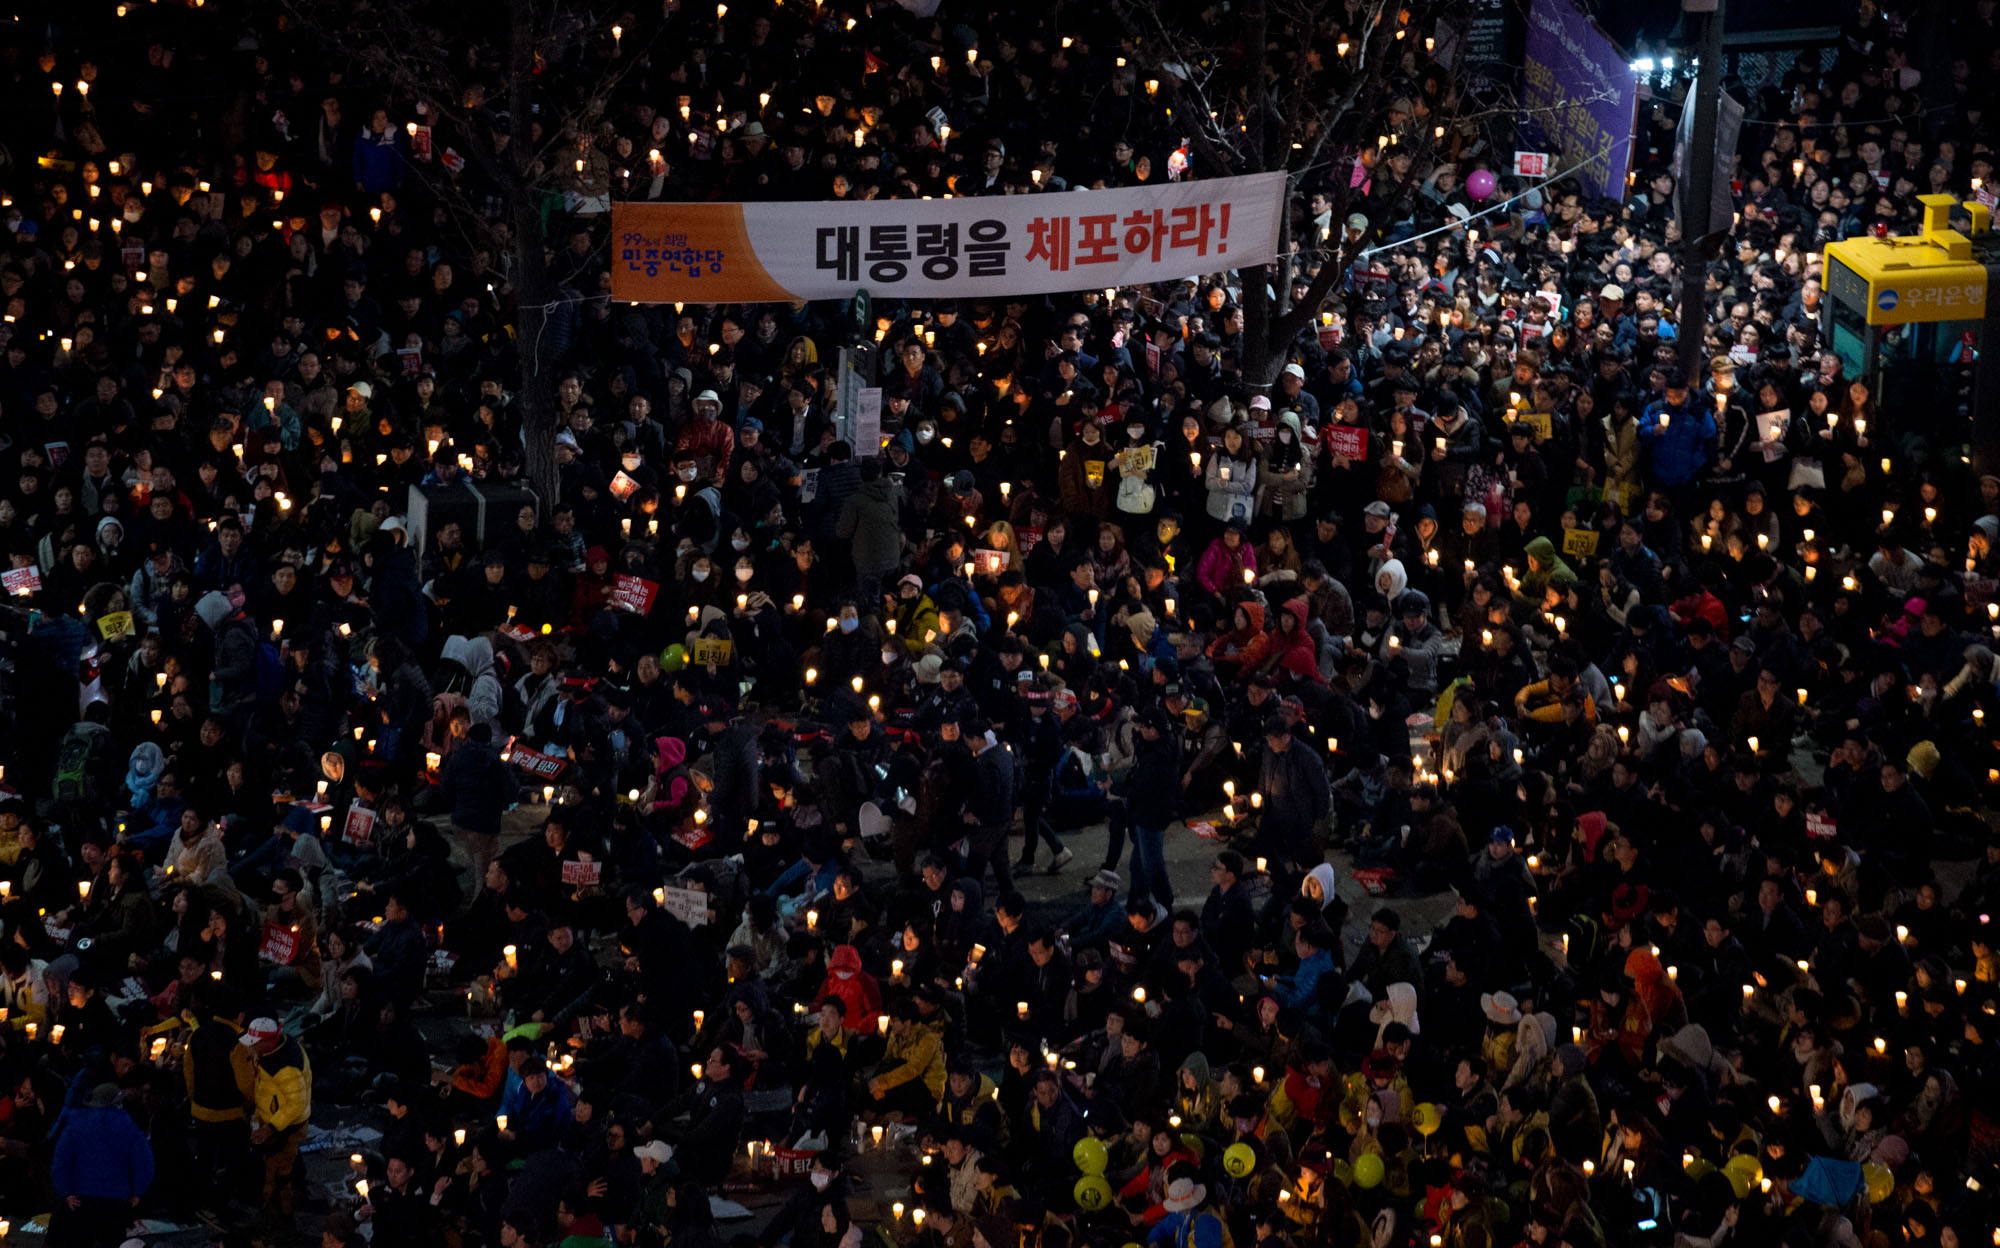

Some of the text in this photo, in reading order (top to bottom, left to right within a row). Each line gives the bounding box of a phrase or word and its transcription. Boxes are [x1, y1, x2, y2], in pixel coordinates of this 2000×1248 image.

[663, 233, 688, 247] 희망
[816, 203, 1233, 283] 대통령을 체포하라!
[623, 248, 725, 278] 민중연합당
[1904, 284, 1984, 308] 우리은행
[511, 750, 560, 775] 박근혜 퇴진!
